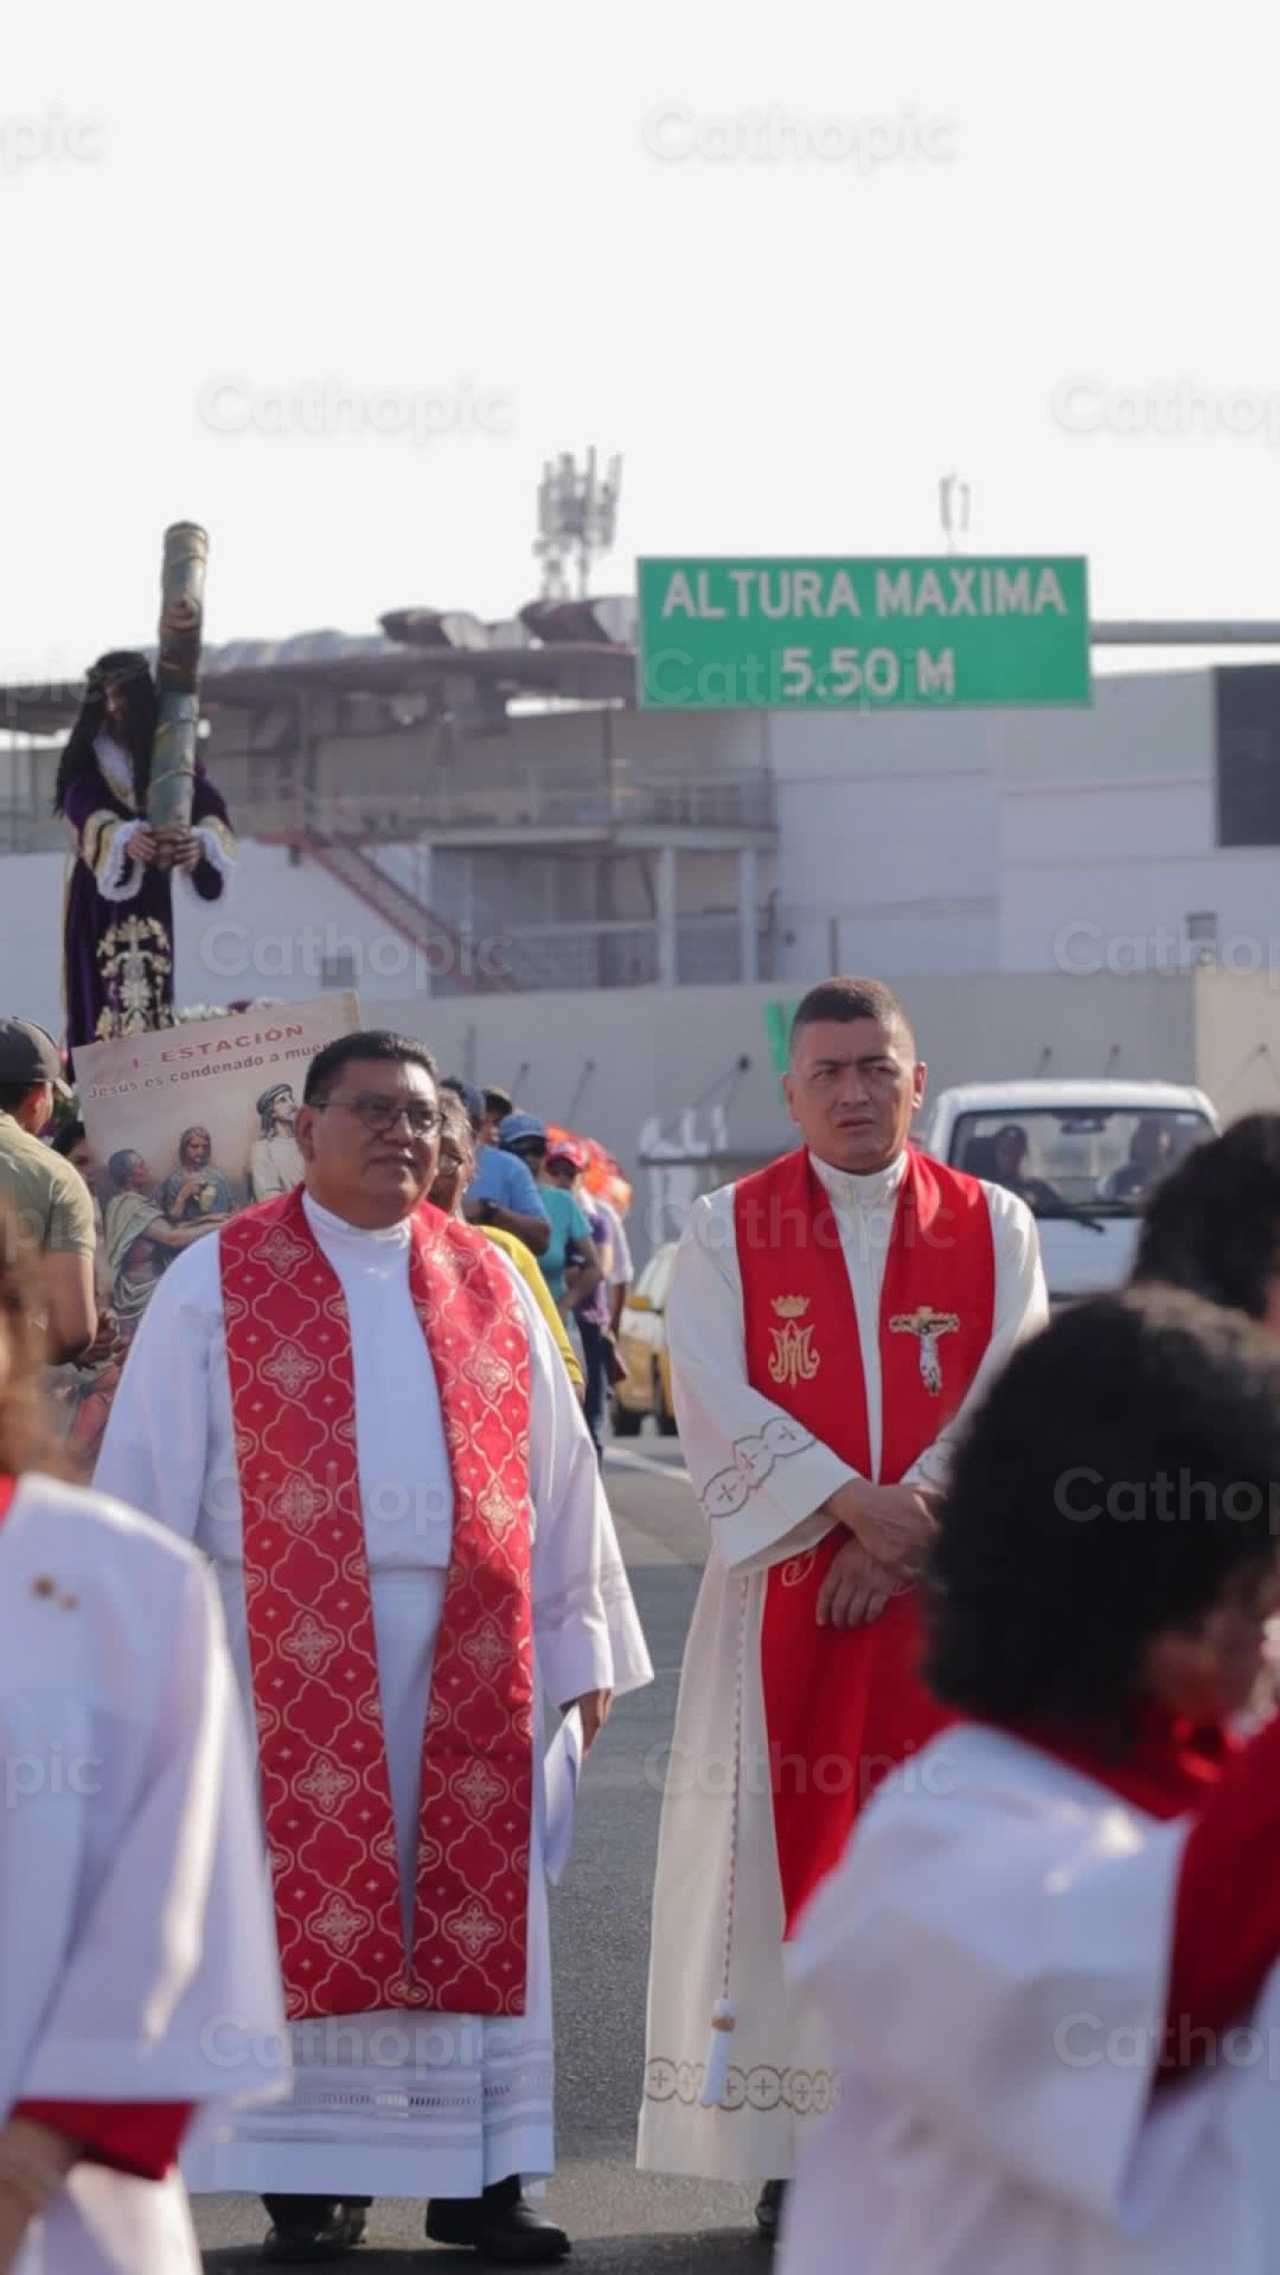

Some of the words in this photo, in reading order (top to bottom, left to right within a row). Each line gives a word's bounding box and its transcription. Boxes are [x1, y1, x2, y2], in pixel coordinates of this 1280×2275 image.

[661, 568, 861, 618] ALTURA
[875, 567, 1067, 617] MAXIMA
[780, 646, 899, 696] 5.50
[916, 646, 956, 695] M
[160, 1023, 305, 1064] ESTACIÓN
[169, 1053, 264, 1084] condenado
[268, 1051, 281, 1064] a
